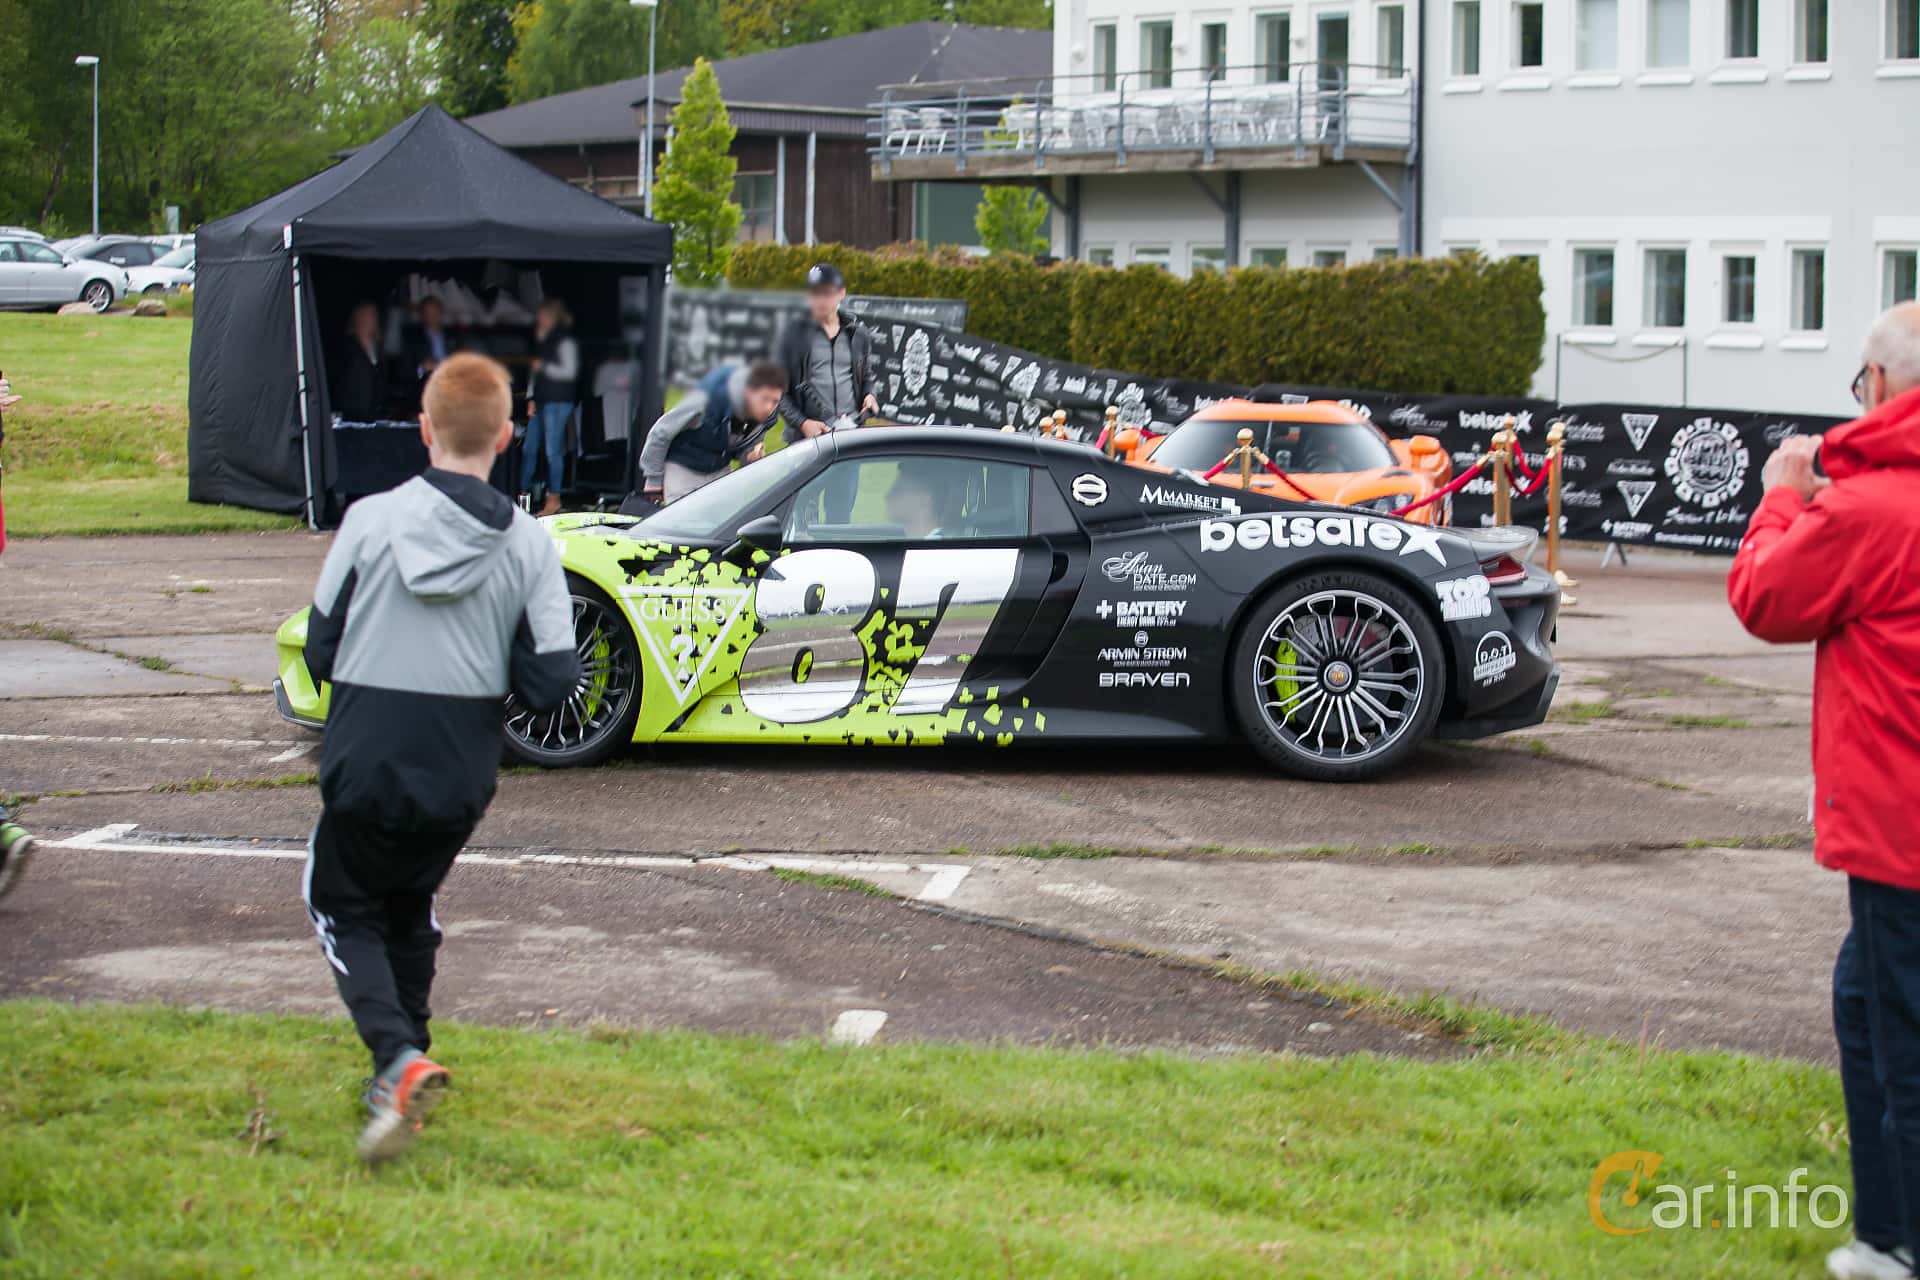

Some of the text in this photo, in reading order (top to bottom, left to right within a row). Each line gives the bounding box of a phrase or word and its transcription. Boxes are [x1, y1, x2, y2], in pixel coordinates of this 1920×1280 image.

[640, 597, 727, 623] GUESS
[1116, 600, 1187, 616] BATTERY
[738, 548, 1019, 723] 87
[1097, 647, 1187, 661] ARMIN STROM
[1099, 672, 1190, 687] BRAVEN
